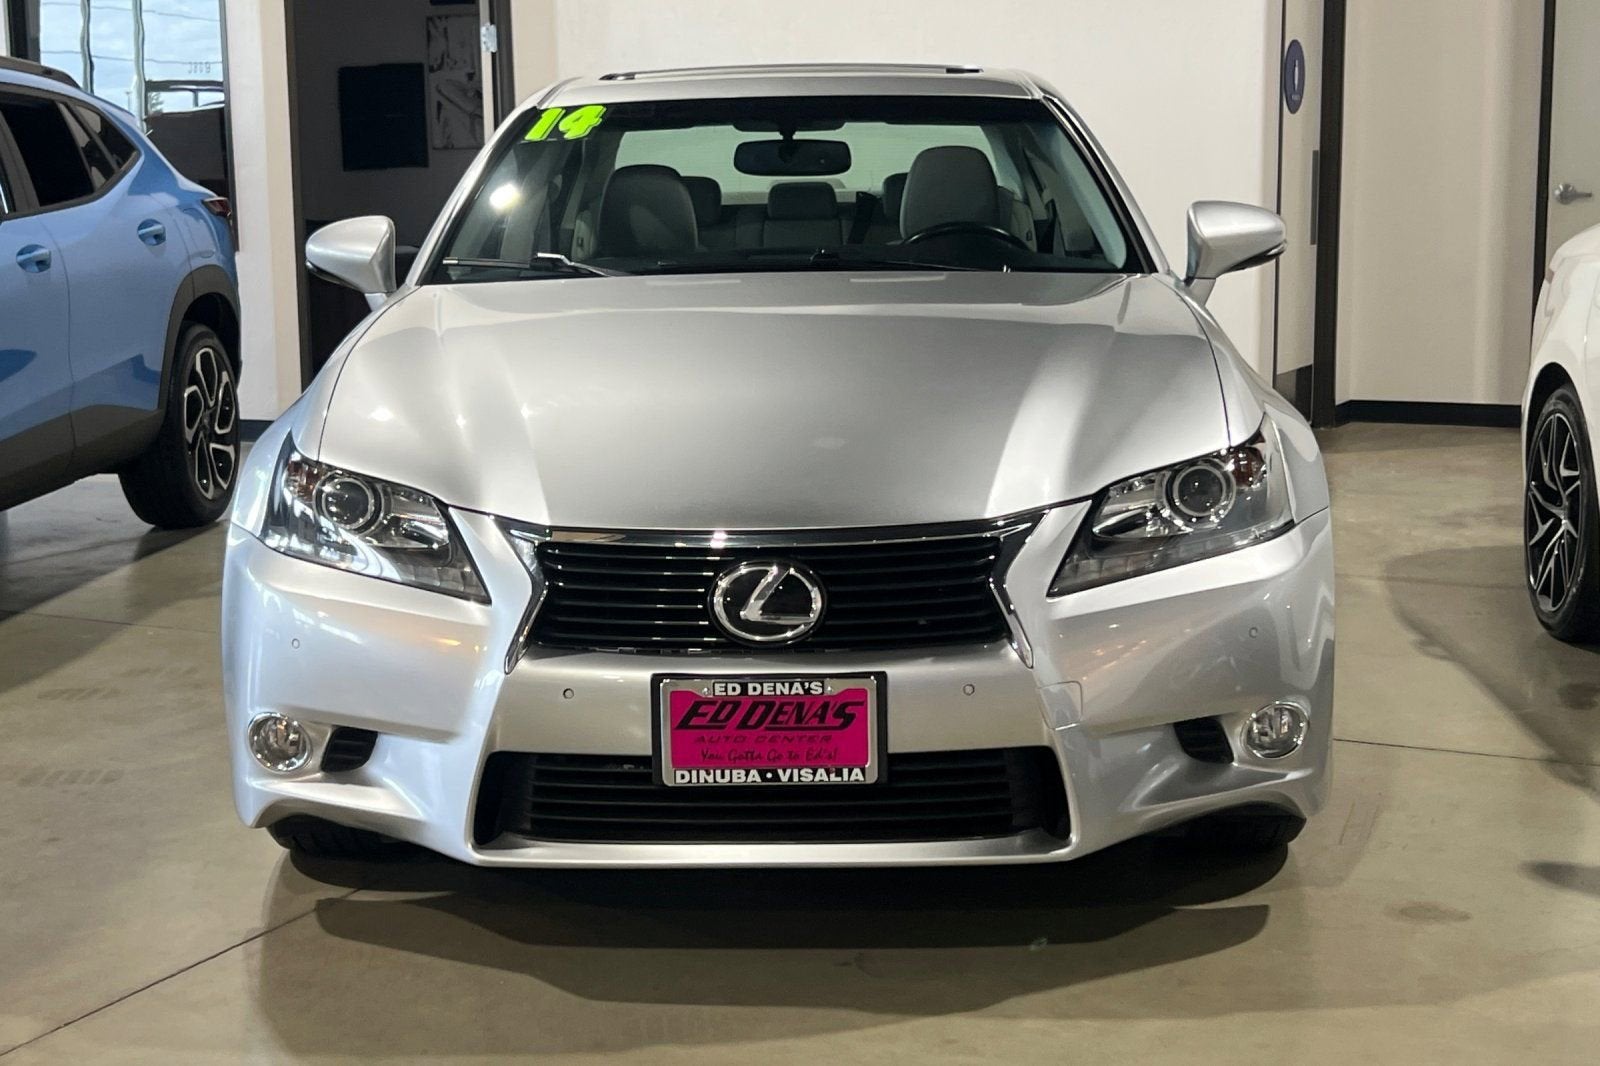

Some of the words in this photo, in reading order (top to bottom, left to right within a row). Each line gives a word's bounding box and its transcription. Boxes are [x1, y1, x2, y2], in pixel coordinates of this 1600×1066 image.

[524, 105, 607, 141] 14
[713, 682, 741, 696] ED
[747, 682, 824, 696] DENA'S
[674, 700, 742, 731] ED
[735, 700, 865, 732] DENA'S
[695, 735, 748, 744] AUTO
[754, 735, 833, 744] CENTER
[701, 748, 724, 763] You
[728, 749, 763, 764] Gotta
[767, 749, 785, 762] Go
[805, 746, 839, 762] Ed's!
[675, 769, 762, 784] DINUBA
[777, 768, 865, 783] VISALIA
